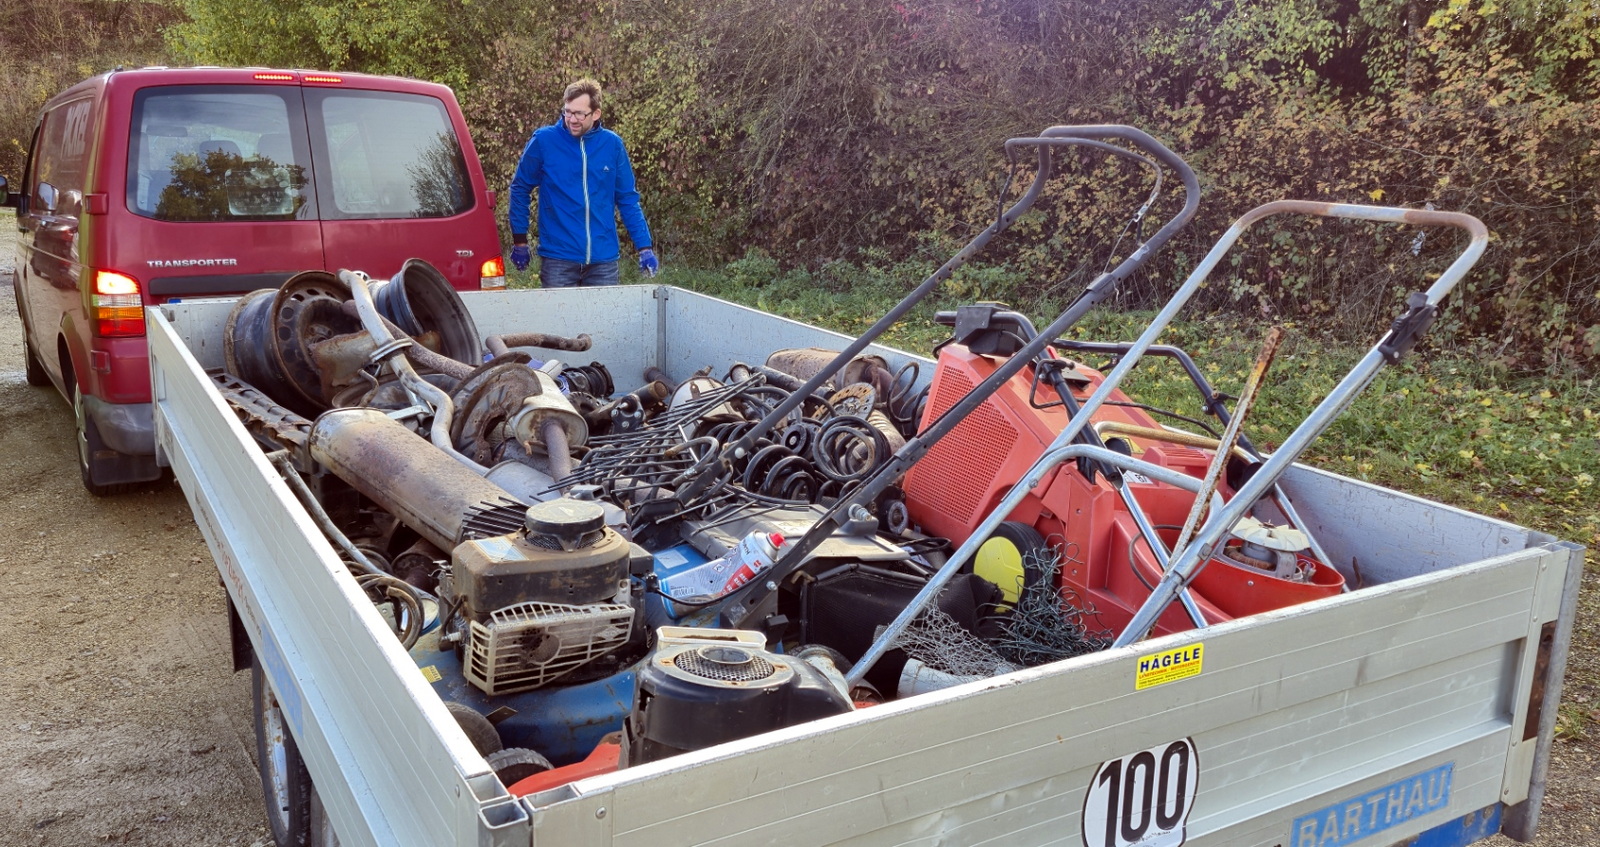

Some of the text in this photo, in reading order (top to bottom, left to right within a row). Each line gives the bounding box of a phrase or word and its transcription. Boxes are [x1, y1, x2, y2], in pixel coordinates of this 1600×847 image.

[147, 258, 237, 267] TRANSPORTER
[1140, 648, 1200, 673] HÄGELE
[1099, 740, 1190, 847] 100
[1299, 770, 1448, 847] BARTHAU
